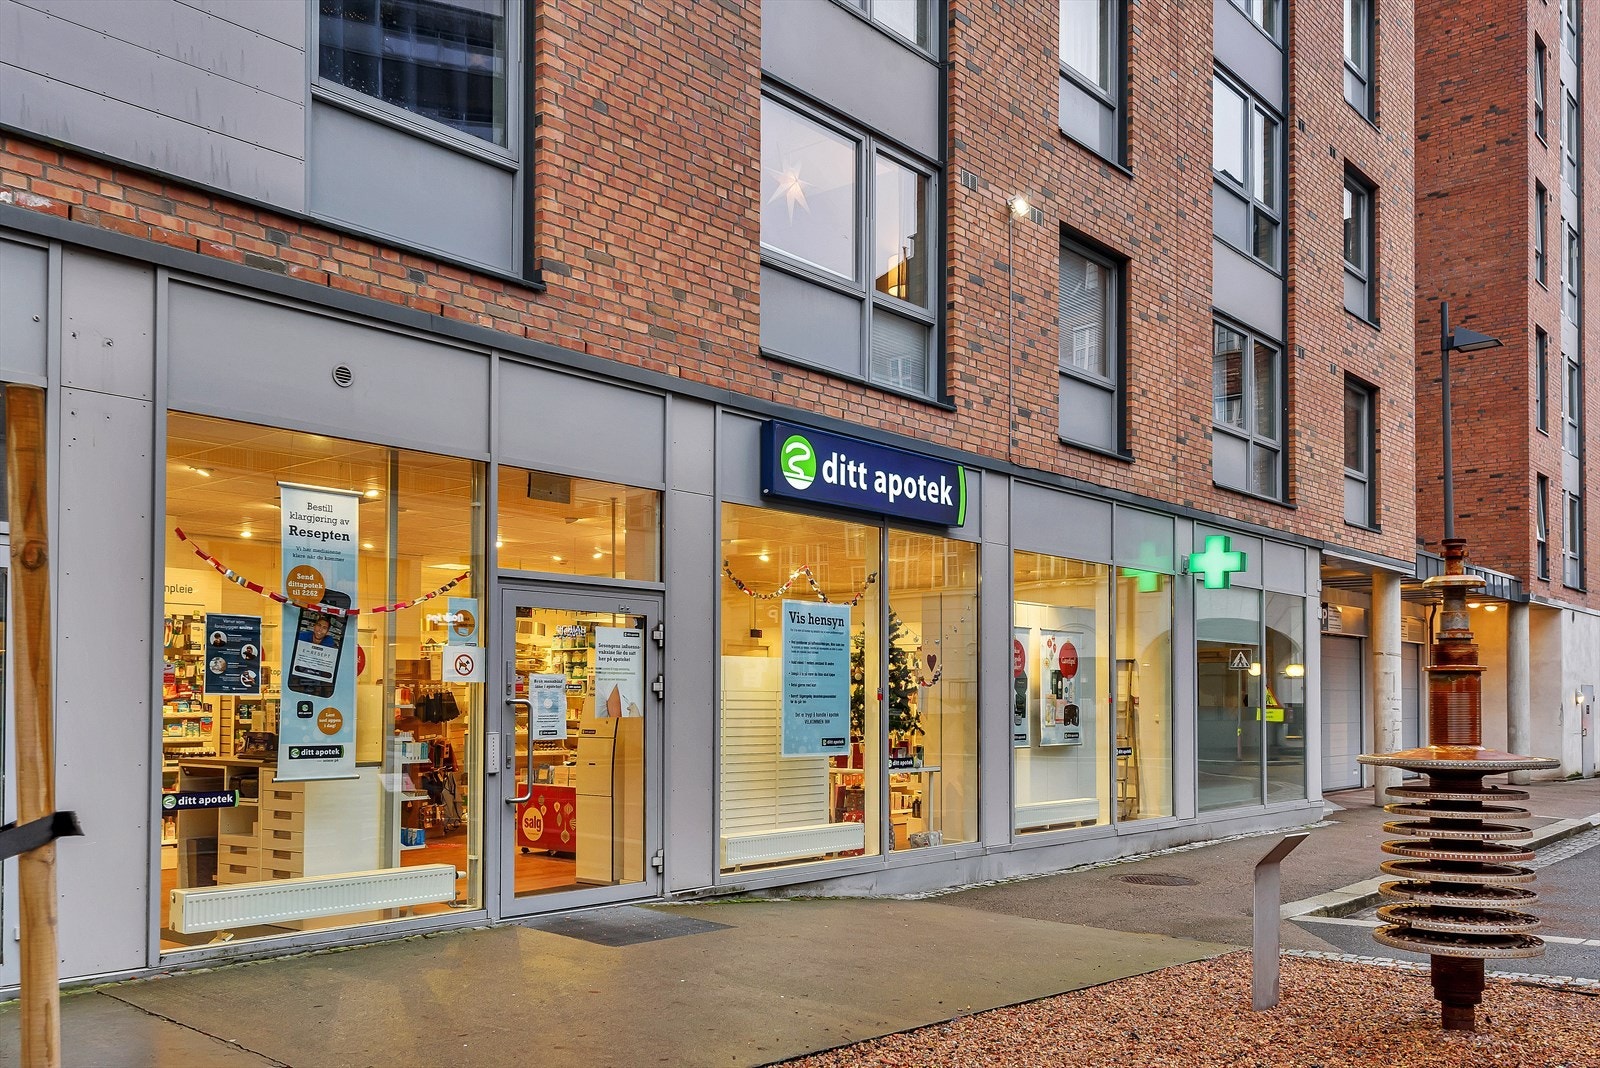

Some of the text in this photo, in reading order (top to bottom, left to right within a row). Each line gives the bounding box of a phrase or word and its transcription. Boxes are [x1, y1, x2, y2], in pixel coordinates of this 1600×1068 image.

[822, 452, 954, 506] ditt apotek
[307, 502, 333, 513] Bestill
[289, 511, 338, 526] klargjøring
[288, 525, 351, 542] Resepten
[296, 573, 314, 581] Send
[288, 581, 323, 590] dittapotek
[789, 611, 845, 630] Vis hensyn
[301, 748, 340, 757] ditt apotek
[178, 794, 234, 806] ditt apotek
[525, 816, 541, 832] salg
